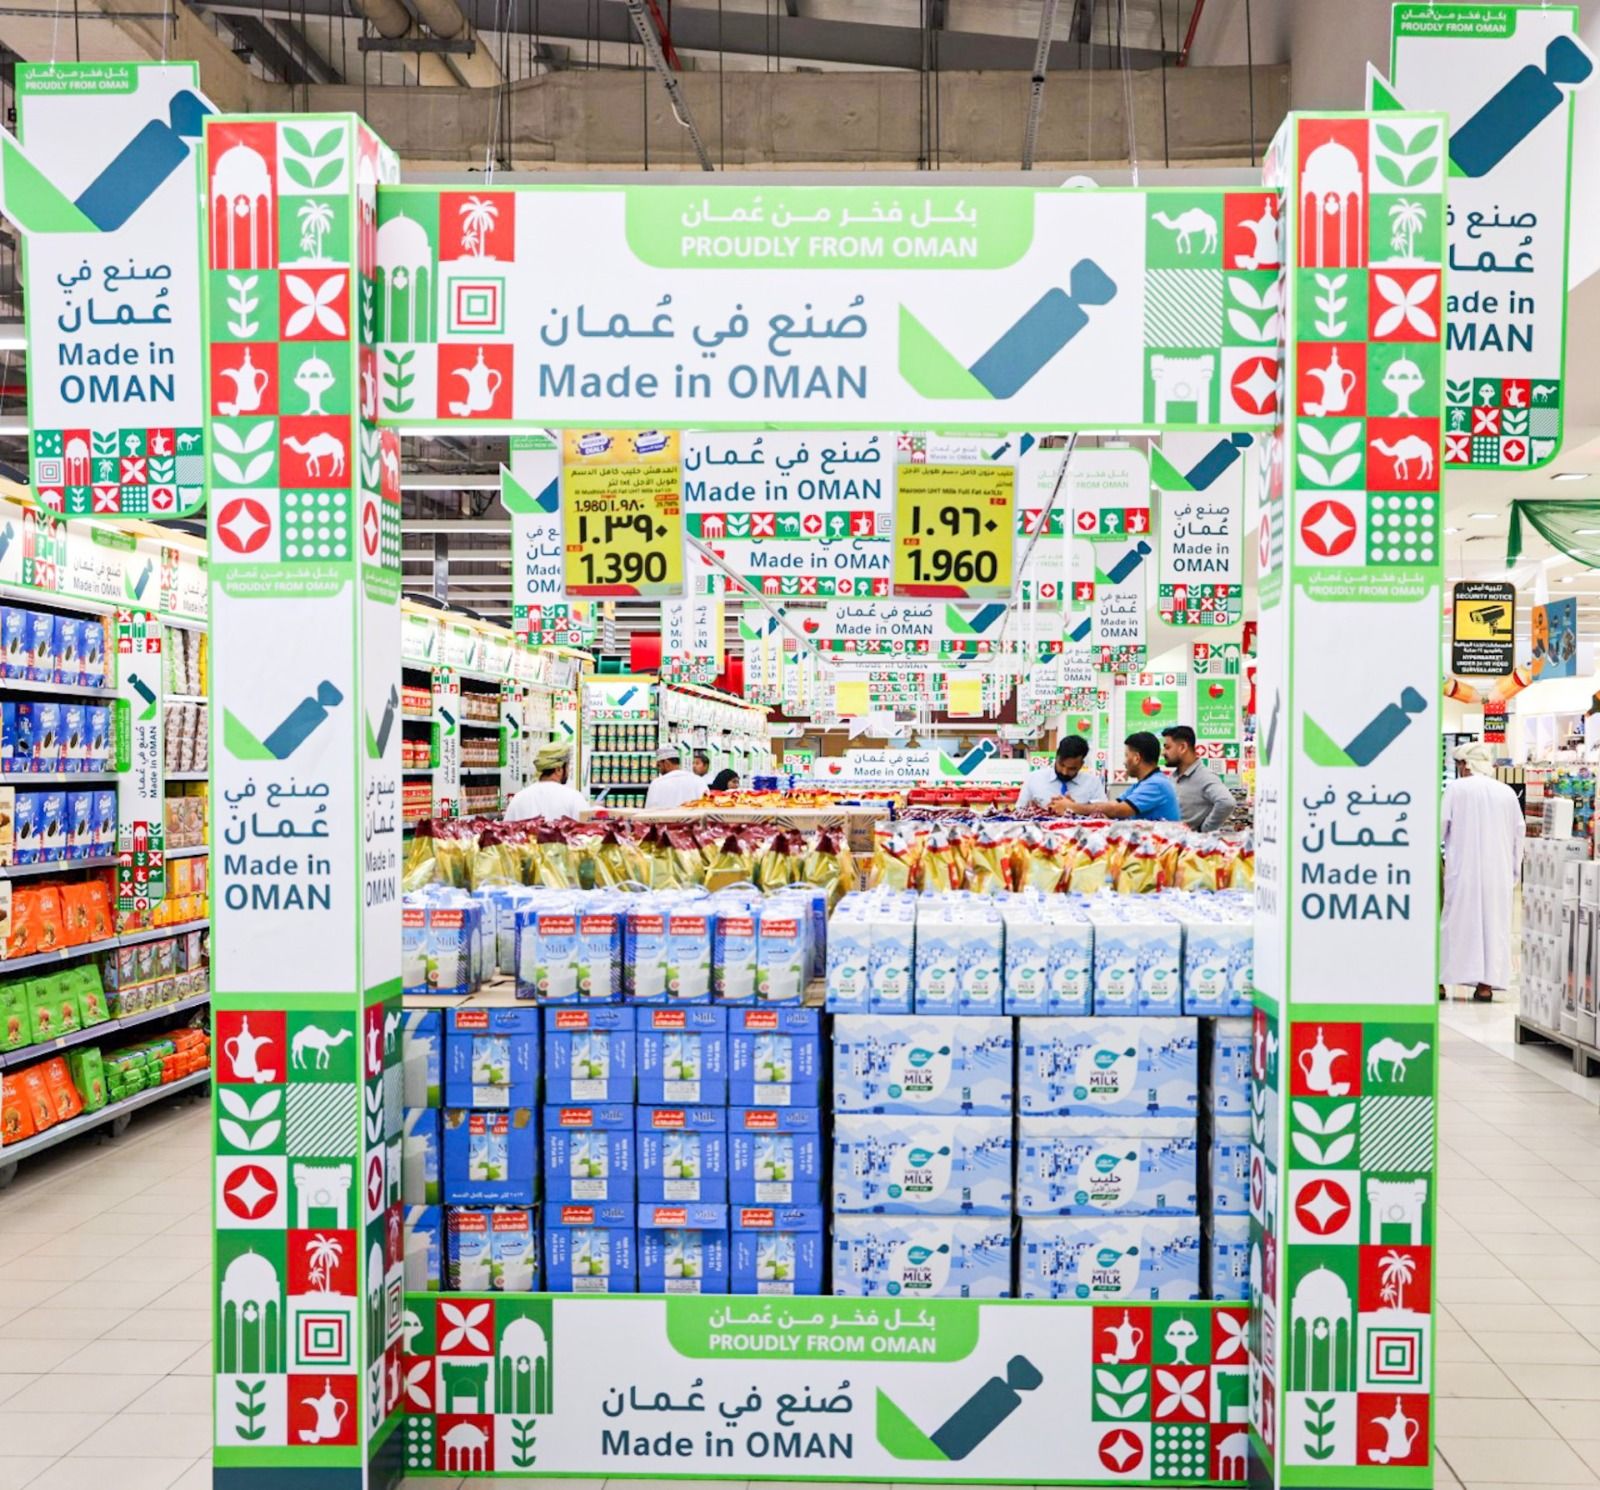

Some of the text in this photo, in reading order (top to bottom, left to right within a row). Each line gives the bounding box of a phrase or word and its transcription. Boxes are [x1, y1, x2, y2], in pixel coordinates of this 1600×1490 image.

[1401, 22, 1507, 33] PROUDLY FROM OMAN
[25, 80, 129, 90] PROUDLY FROM OMAN
[771, 204, 831, 227] من
[840, 201, 904, 227] فخر
[910, 199, 977, 227] بكل
[1466, 204, 1537, 241] صنع
[681, 236, 978, 257] PROUDLY FROM OMAN
[57, 258, 172, 296] صنع في
[1447, 289, 1535, 315] ade in
[692, 303, 749, 359] في
[1446, 322, 1534, 353] MAN
[58, 341, 175, 366] Made in
[60, 373, 175, 404] OMAN
[539, 363, 867, 399] Made in OMAN
[775, 443, 809, 477] في
[684, 478, 881, 502] Made in OMAN
[574, 500, 608, 512] 1.980
[579, 514, 668, 544] ١.٣٩٠
[911, 505, 998, 537] ١.٩٦٠
[750, 551, 828, 569] Made in
[1173, 542, 1230, 555] Made in
[580, 551, 667, 584] 1.390
[907, 549, 998, 583] 1.960
[1173, 558, 1229, 573] OMAN
[226, 581, 339, 592] PROUDLY FROM OMAN
[1308, 586, 1425, 596] PROUDLY FROM OMAN
[836, 623, 933, 636] Made in OMAN
[1100, 618, 1138, 626] Made in
[1100, 628, 1138, 638] OMAN
[149, 726, 157, 757] OMAN
[1202, 727, 1231, 735] OMAN
[854, 765, 930, 777] Made in OMAN
[224, 777, 330, 811] صنع في
[1302, 784, 1412, 817] صنع في
[224, 853, 331, 876] Made in
[365, 847, 395, 872] Made in
[1301, 862, 1411, 886] Made in
[224, 883, 331, 911] OMAN
[366, 876, 395, 907] OMAN
[1301, 892, 1410, 921] OMAN
[904, 1075, 933, 1084] MILK
[1089, 1076, 1119, 1086] MILK
[904, 1175, 933, 1184] MILK
[1089, 1173, 1122, 1186] حليب
[903, 1273, 932, 1282] MILK
[1091, 1274, 1121, 1284] MILK
[776, 1310, 825, 1330] من
[829, 1309, 880, 1330] فخر
[884, 1308, 937, 1332] بكل
[709, 1333, 937, 1354] PROUDLY FROM OMAN
[718, 1385, 763, 1428] في
[601, 1429, 853, 1460] Made in OMAN
